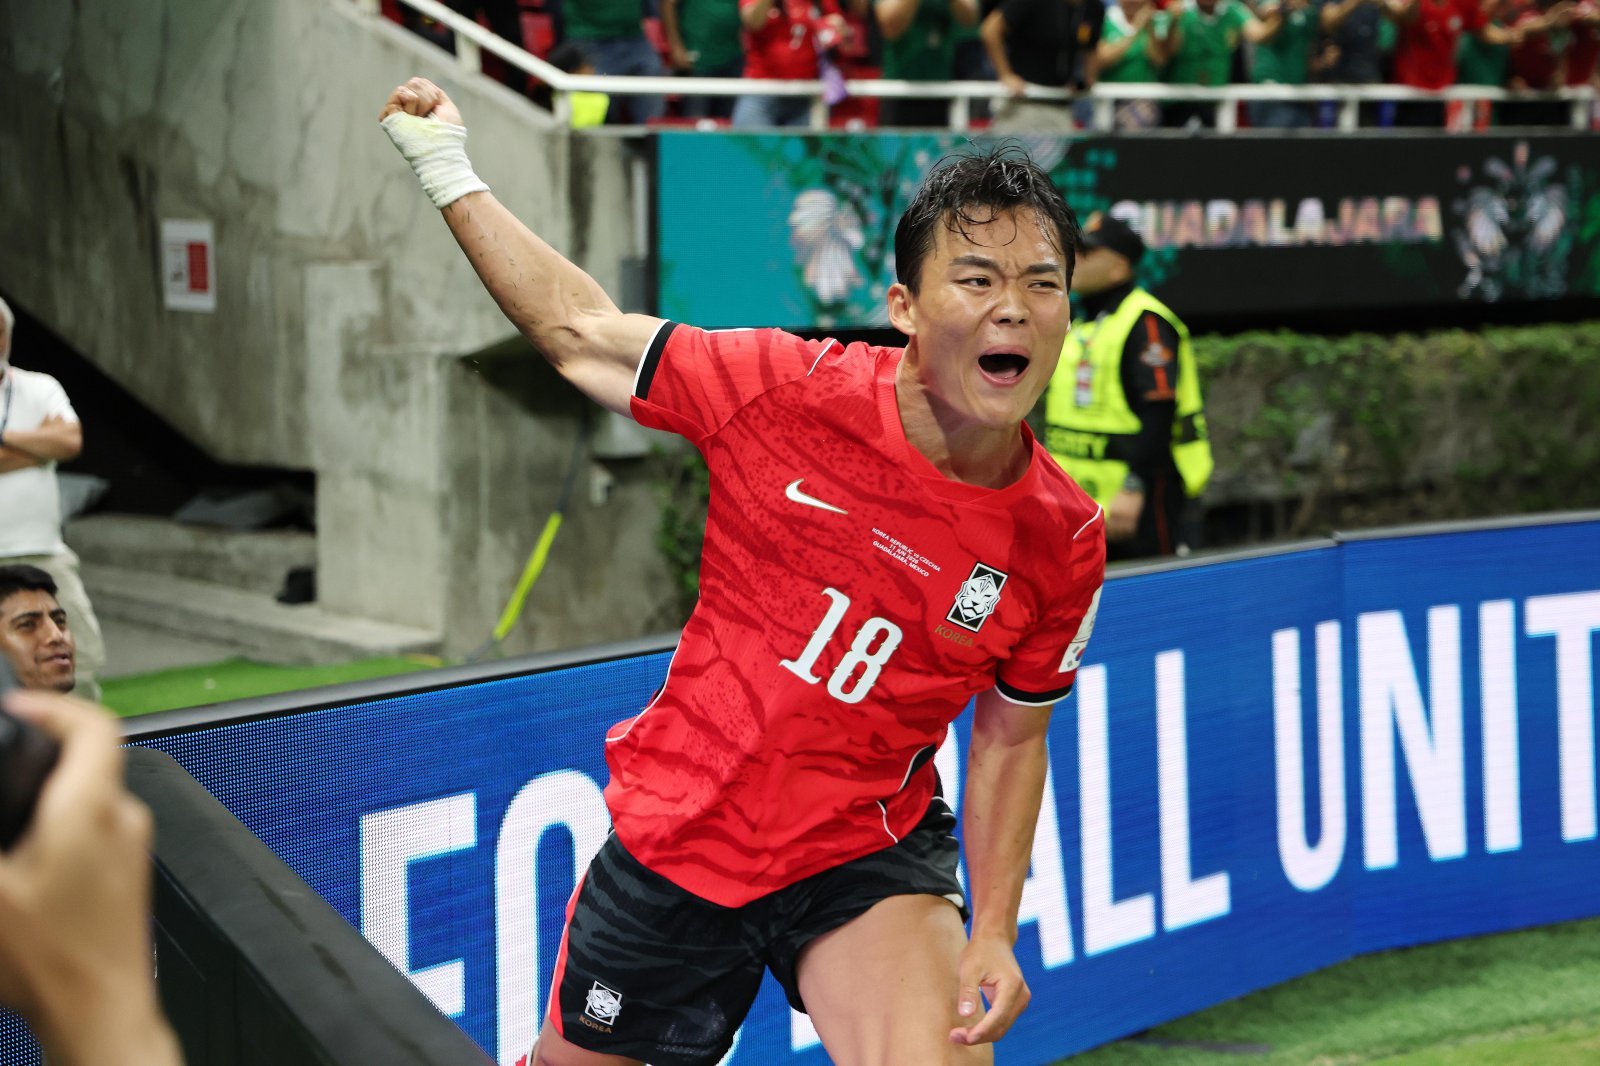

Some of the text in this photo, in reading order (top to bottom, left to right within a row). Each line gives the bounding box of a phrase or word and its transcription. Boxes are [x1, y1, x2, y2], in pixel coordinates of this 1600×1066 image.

[872, 527, 890, 541] KOREA
[890, 537, 914, 555] REPUBLIC
[919, 556, 941, 572] CZECHIA
[896, 548, 907, 557] JUN
[908, 562, 930, 577] MEXICO
[778, 587, 903, 704] 18
[935, 624, 974, 648] KOREA
[578, 1014, 612, 1034] KOREA
